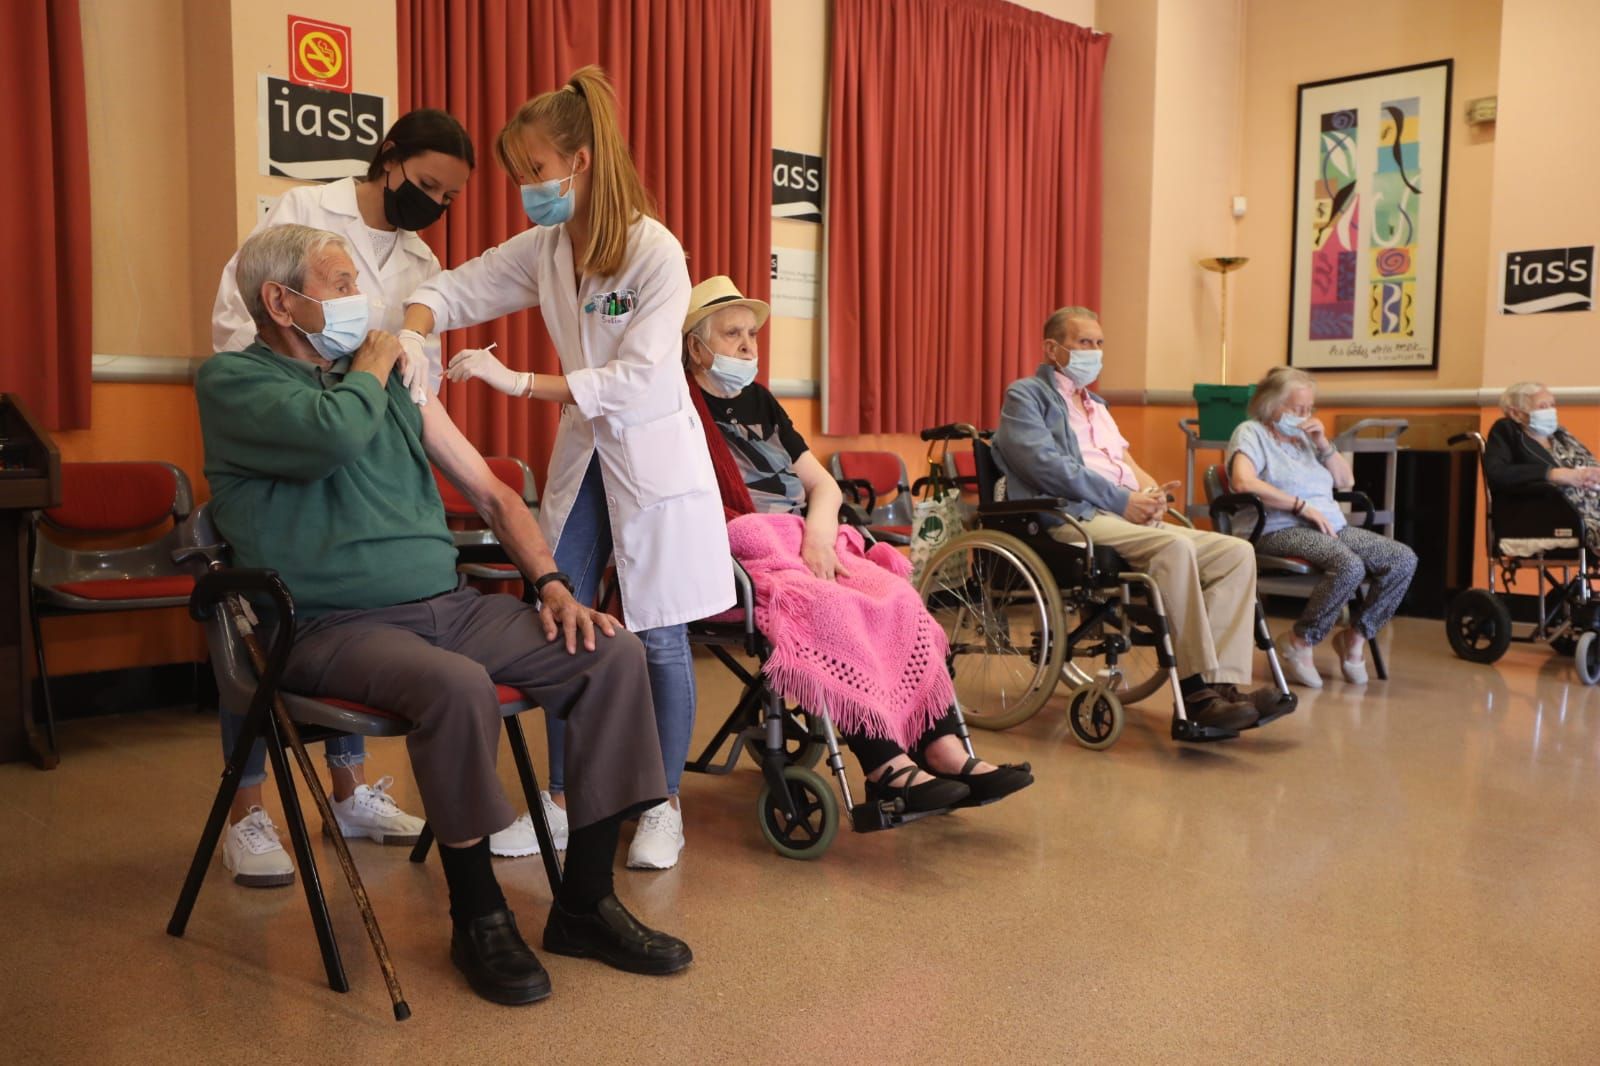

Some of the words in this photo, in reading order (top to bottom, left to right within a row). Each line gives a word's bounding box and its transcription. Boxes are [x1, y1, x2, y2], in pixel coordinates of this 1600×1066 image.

[274, 86, 379, 147] iass
[772, 163, 820, 192] ass
[1509, 255, 1588, 286] iass
